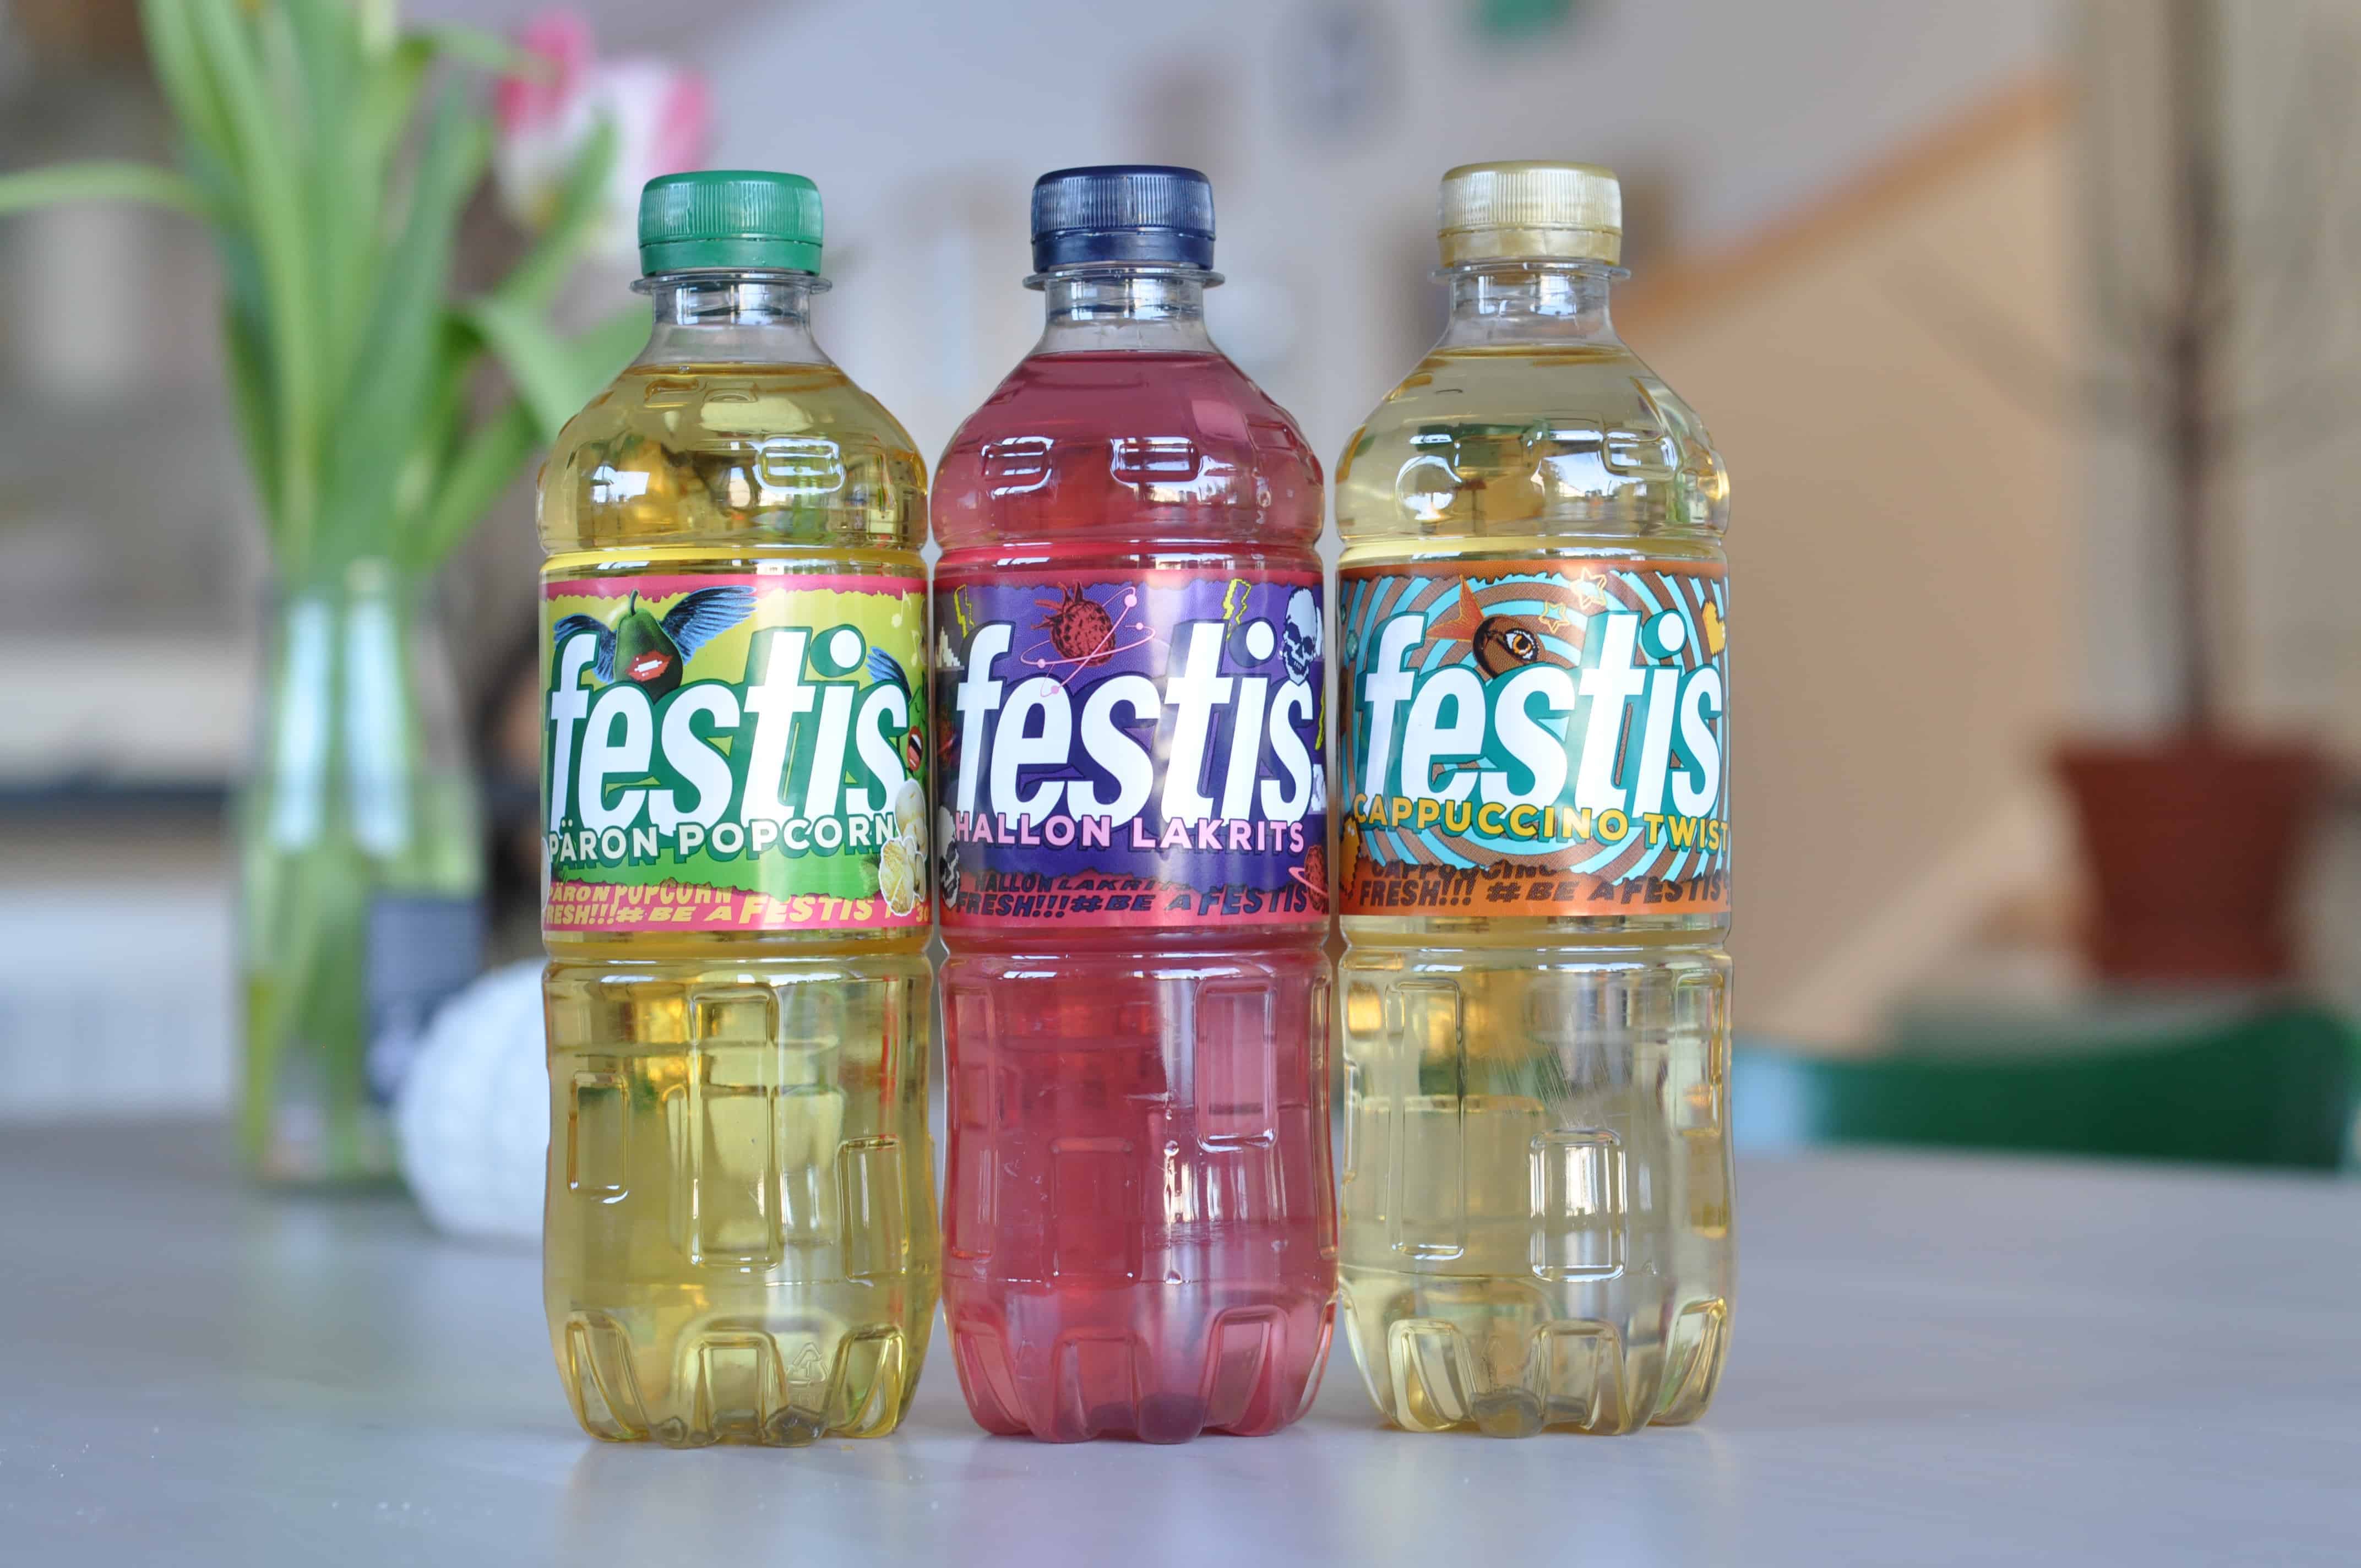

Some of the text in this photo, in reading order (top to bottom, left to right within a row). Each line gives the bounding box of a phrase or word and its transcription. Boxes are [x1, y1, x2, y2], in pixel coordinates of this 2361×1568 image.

[550, 629, 908, 837] festis
[956, 621, 1314, 831] festis
[1364, 612, 1722, 820] festis
[548, 812, 894, 863] PÄRON POPCORN
[955, 812, 1305, 853] HALLON LAKRITS
[1353, 793, 1728, 852] CAPPUCCINO TWIST
[545, 903, 619, 925] RESH!!!
[704, 906, 732, 921] A
[738, 894, 875, 924] FESTIS
[957, 892, 1069, 918] FRESH!!!
[1164, 894, 1192, 911] A
[1197, 884, 1308, 916] FESTIS
[1359, 879, 1477, 906] FRESH!!!
[1586, 880, 1615, 901] A
[1620, 870, 1722, 905] FESTIS
